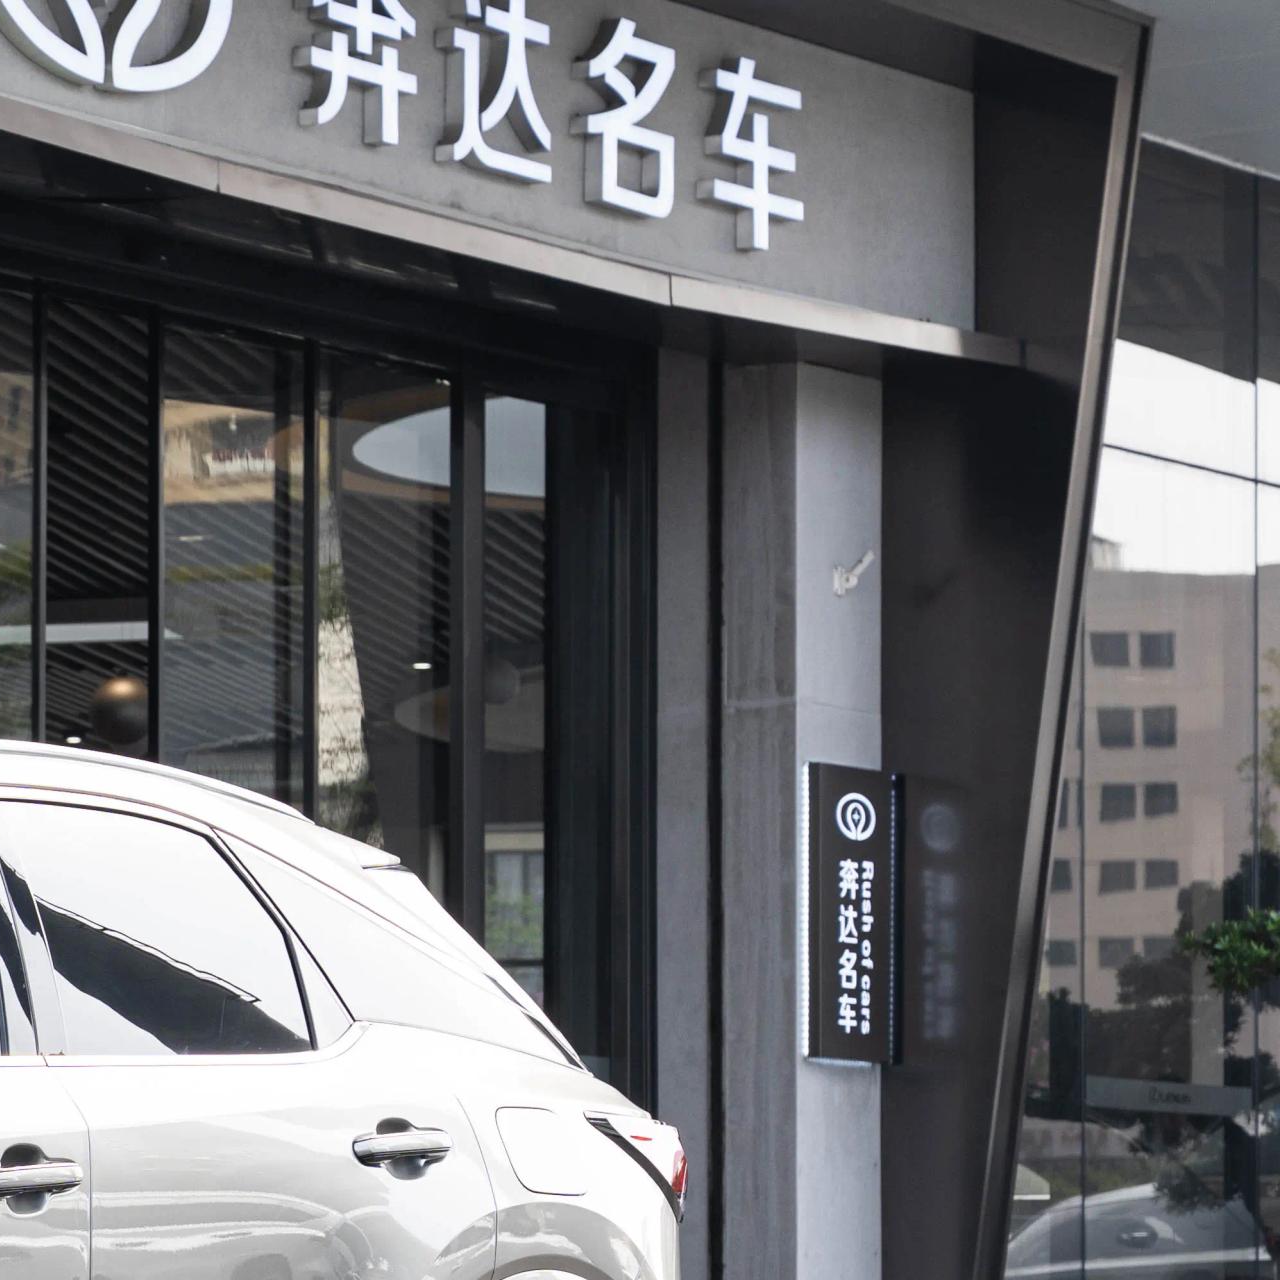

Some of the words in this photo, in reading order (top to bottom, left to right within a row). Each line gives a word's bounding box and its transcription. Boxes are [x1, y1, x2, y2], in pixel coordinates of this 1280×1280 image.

[300, 0, 805, 251] 奔达名车
[861, 860, 875, 933] Rush
[838, 858, 860, 1034] 奔达名车
[861, 939, 874, 970] of
[861, 974, 871, 1035] cars
